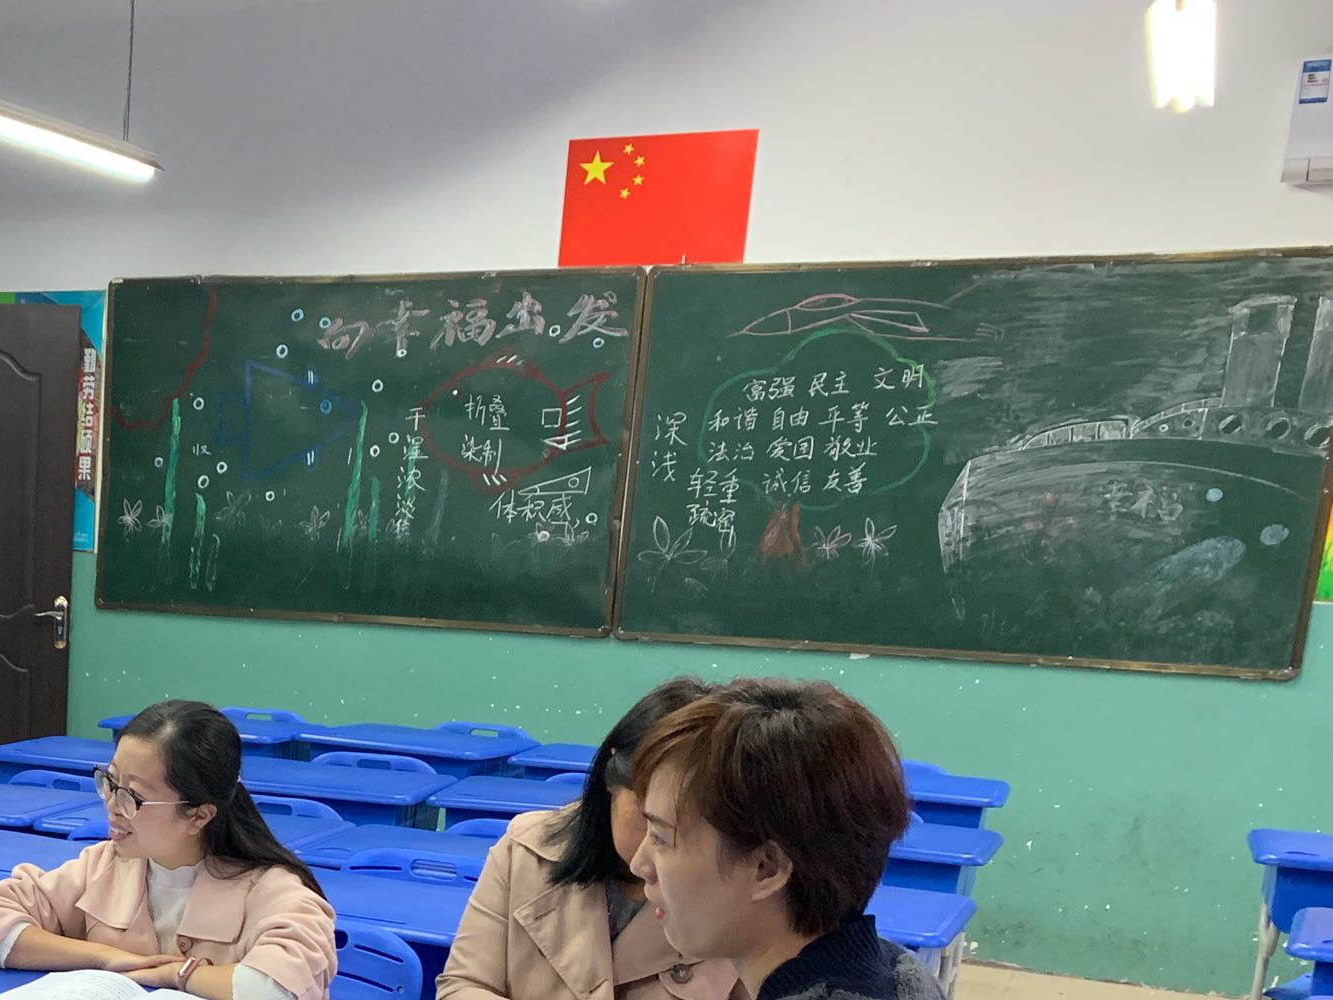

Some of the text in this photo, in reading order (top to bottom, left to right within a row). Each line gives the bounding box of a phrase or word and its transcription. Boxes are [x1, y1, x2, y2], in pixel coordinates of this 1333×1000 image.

[743, 364, 924, 401] 富强 民主 文明
[465, 394, 510, 430] 折叠
[708, 402, 939, 433] 和谐 自由 平等 公正
[707, 435, 877, 463] 法治 爱国 敬业
[687, 468, 739, 503] 轻重
[762, 462, 867, 495] 诚信 友善
